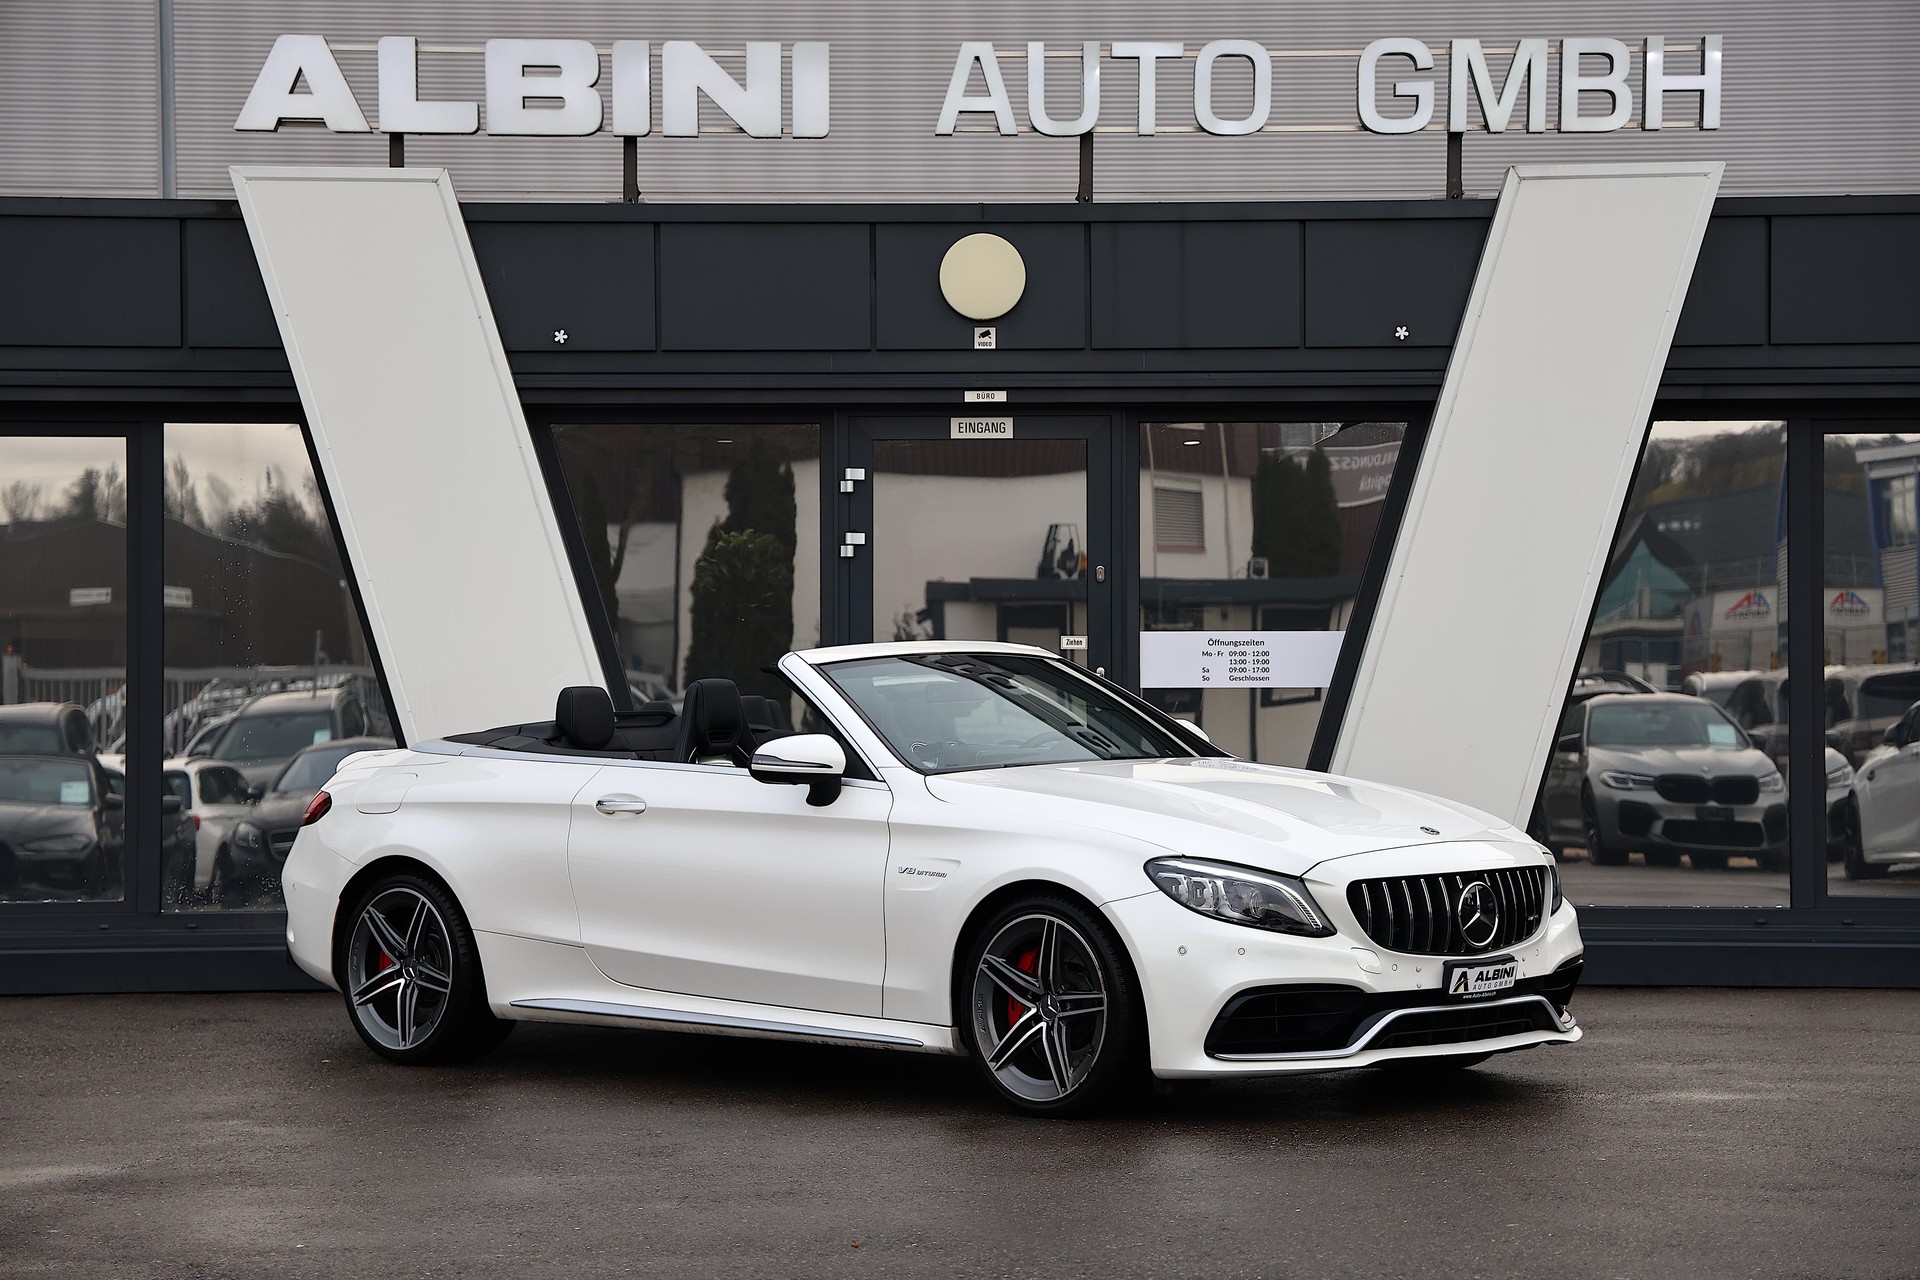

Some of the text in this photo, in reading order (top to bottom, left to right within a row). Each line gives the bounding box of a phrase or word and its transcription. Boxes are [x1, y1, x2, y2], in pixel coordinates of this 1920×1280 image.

[234, 34, 1723, 138] ALBINI AUTO GMBH
[976, 391, 995, 400] BÜRO
[958, 422, 1006, 434] EINGANG
[1207, 638, 1265, 647] Öffnungszeiten
[1474, 966, 1515, 983] ALBINI
[1473, 980, 1512, 990] AUTO GMBH
